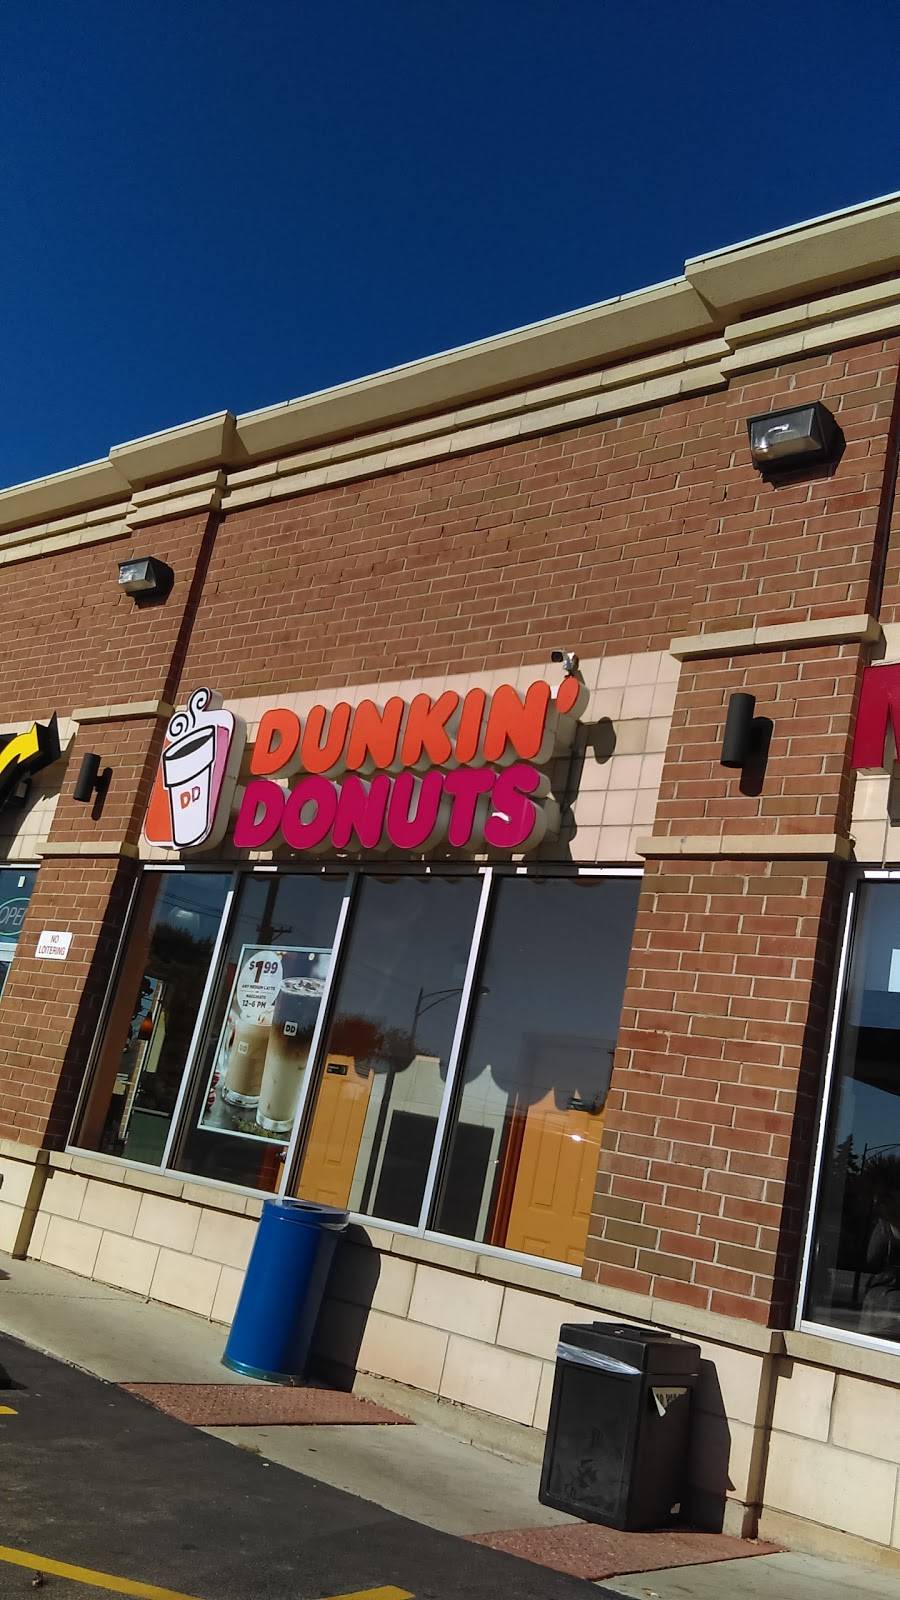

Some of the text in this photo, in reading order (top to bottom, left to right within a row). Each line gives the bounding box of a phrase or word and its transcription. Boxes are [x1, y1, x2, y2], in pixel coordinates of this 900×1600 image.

[250, 676, 580, 775] DUNKIN'
[180, 786, 201, 809] DD
[234, 764, 540, 849] DONUTS
[0, 906, 25, 926] OPE
[51, 935, 60, 943] NO
[38, 945, 66, 956] LOITERING
[242, 999, 267, 1009] 12-6 PM
[285, 1024, 296, 1034] DD
